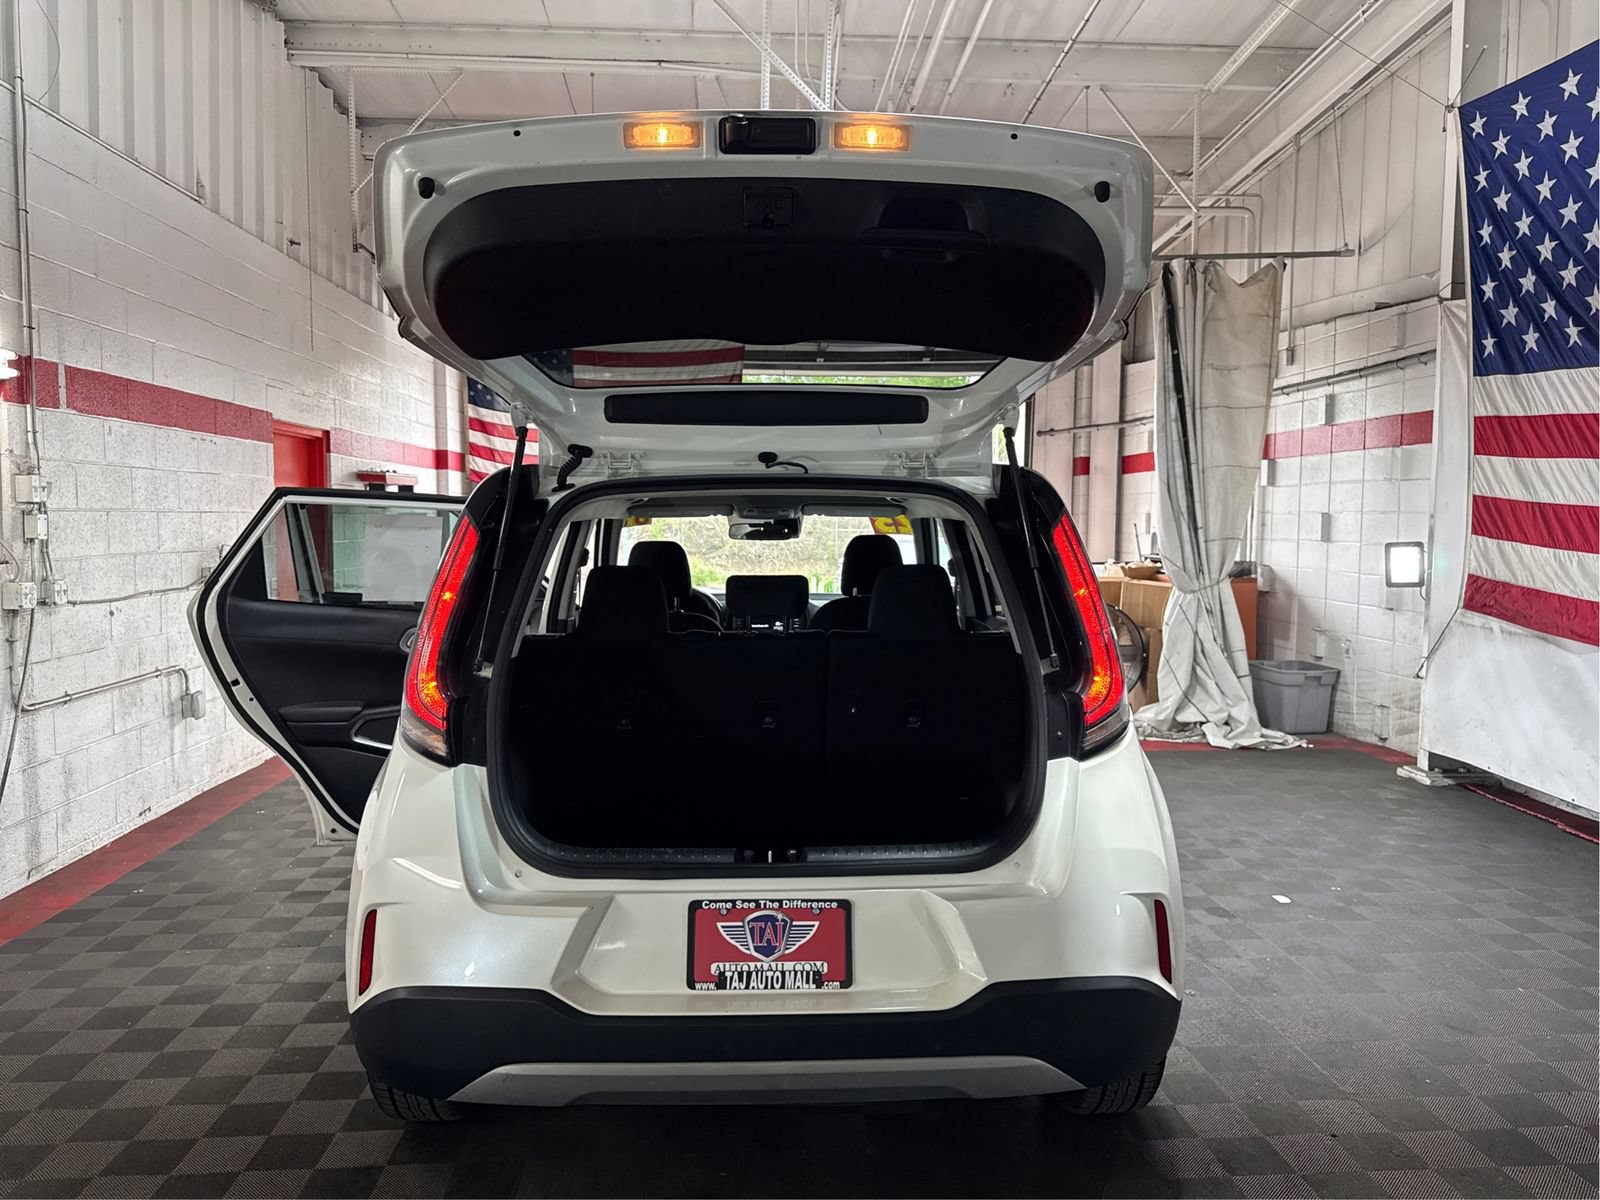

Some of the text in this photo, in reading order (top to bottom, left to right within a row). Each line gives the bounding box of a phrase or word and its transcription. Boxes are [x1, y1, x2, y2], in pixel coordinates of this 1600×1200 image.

[702, 900, 838, 910] Come See The Difference
[749, 921, 785, 953] TAJ
[695, 982, 717, 991] www.
[725, 972, 748, 990] TAJ
[749, 972, 782, 990] AUTO
[784, 971, 817, 989] MALL
